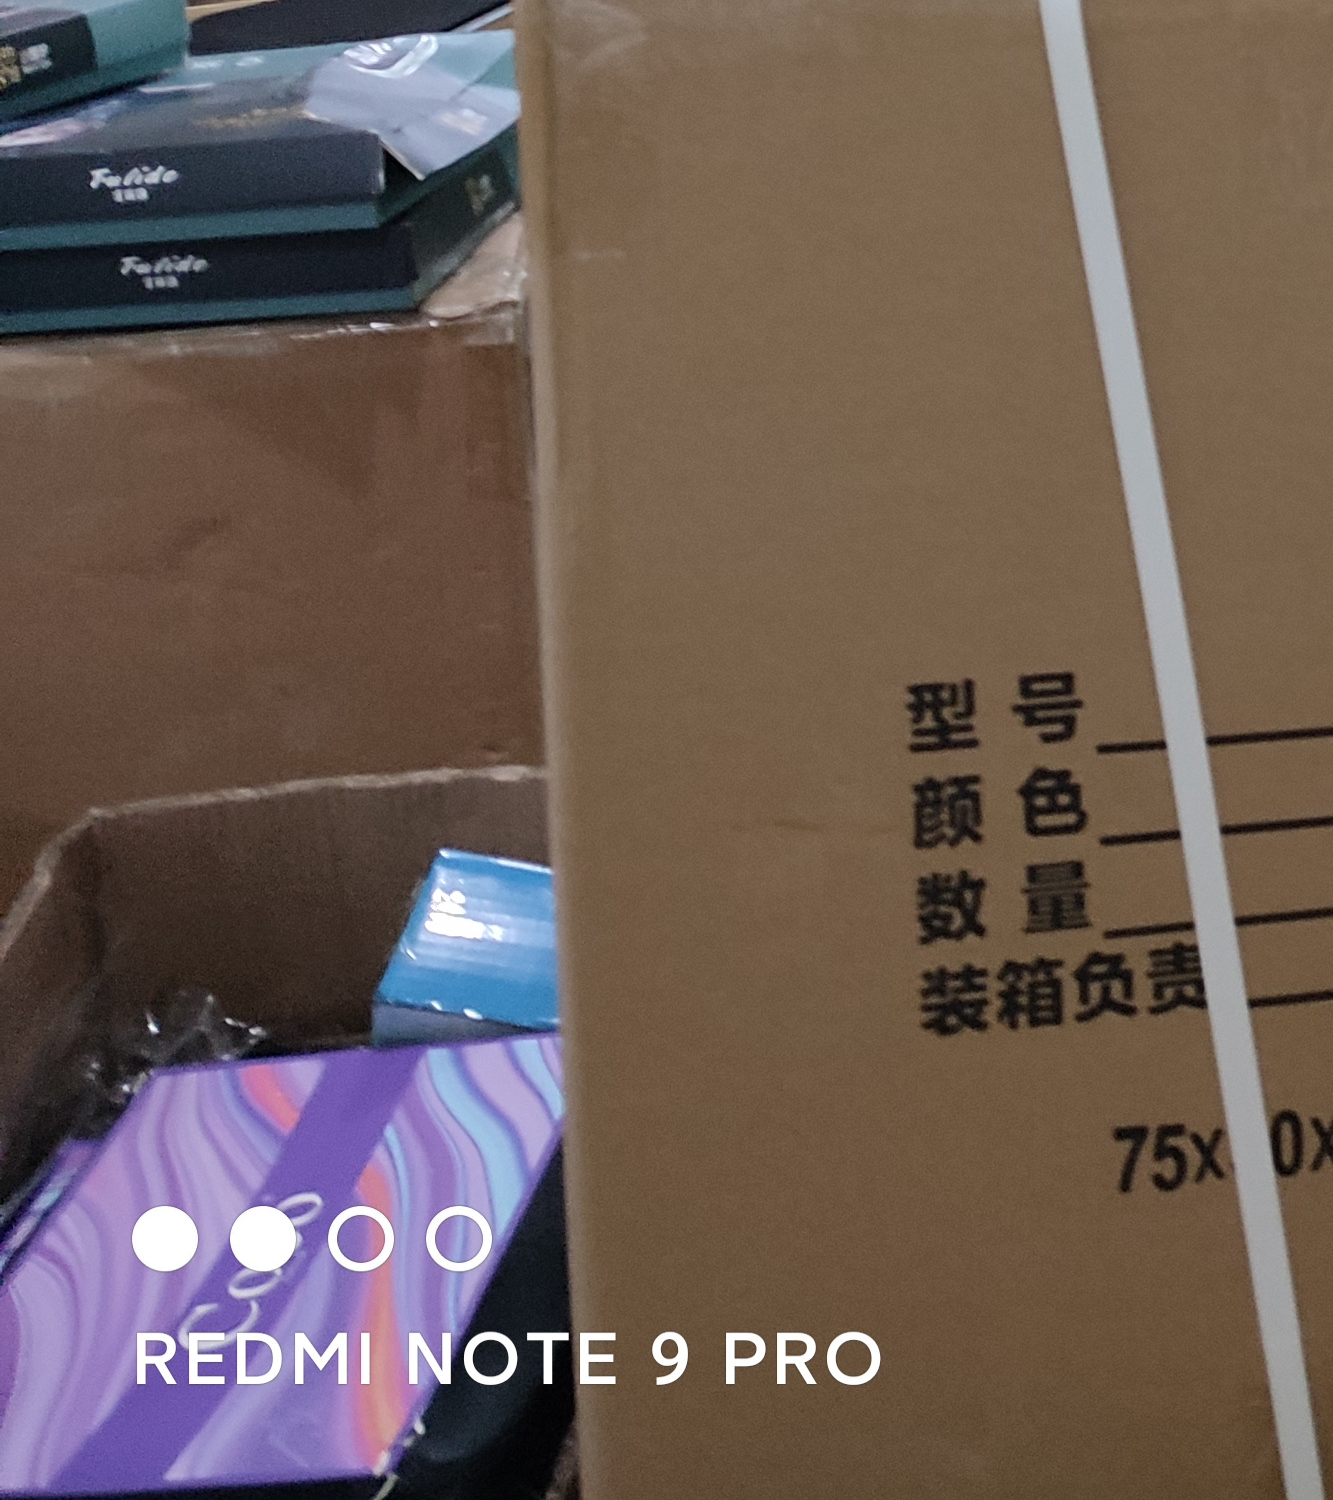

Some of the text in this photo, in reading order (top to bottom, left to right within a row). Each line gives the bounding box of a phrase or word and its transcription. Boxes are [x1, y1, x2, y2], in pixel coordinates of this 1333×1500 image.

[906, 671, 1084, 753] 型号
[912, 766, 1088, 850] 颜色
[916, 860, 1093, 946] 数量
[920, 941, 1209, 1037] 装箱负责
[178, 1191, 323, 1350] Coo
